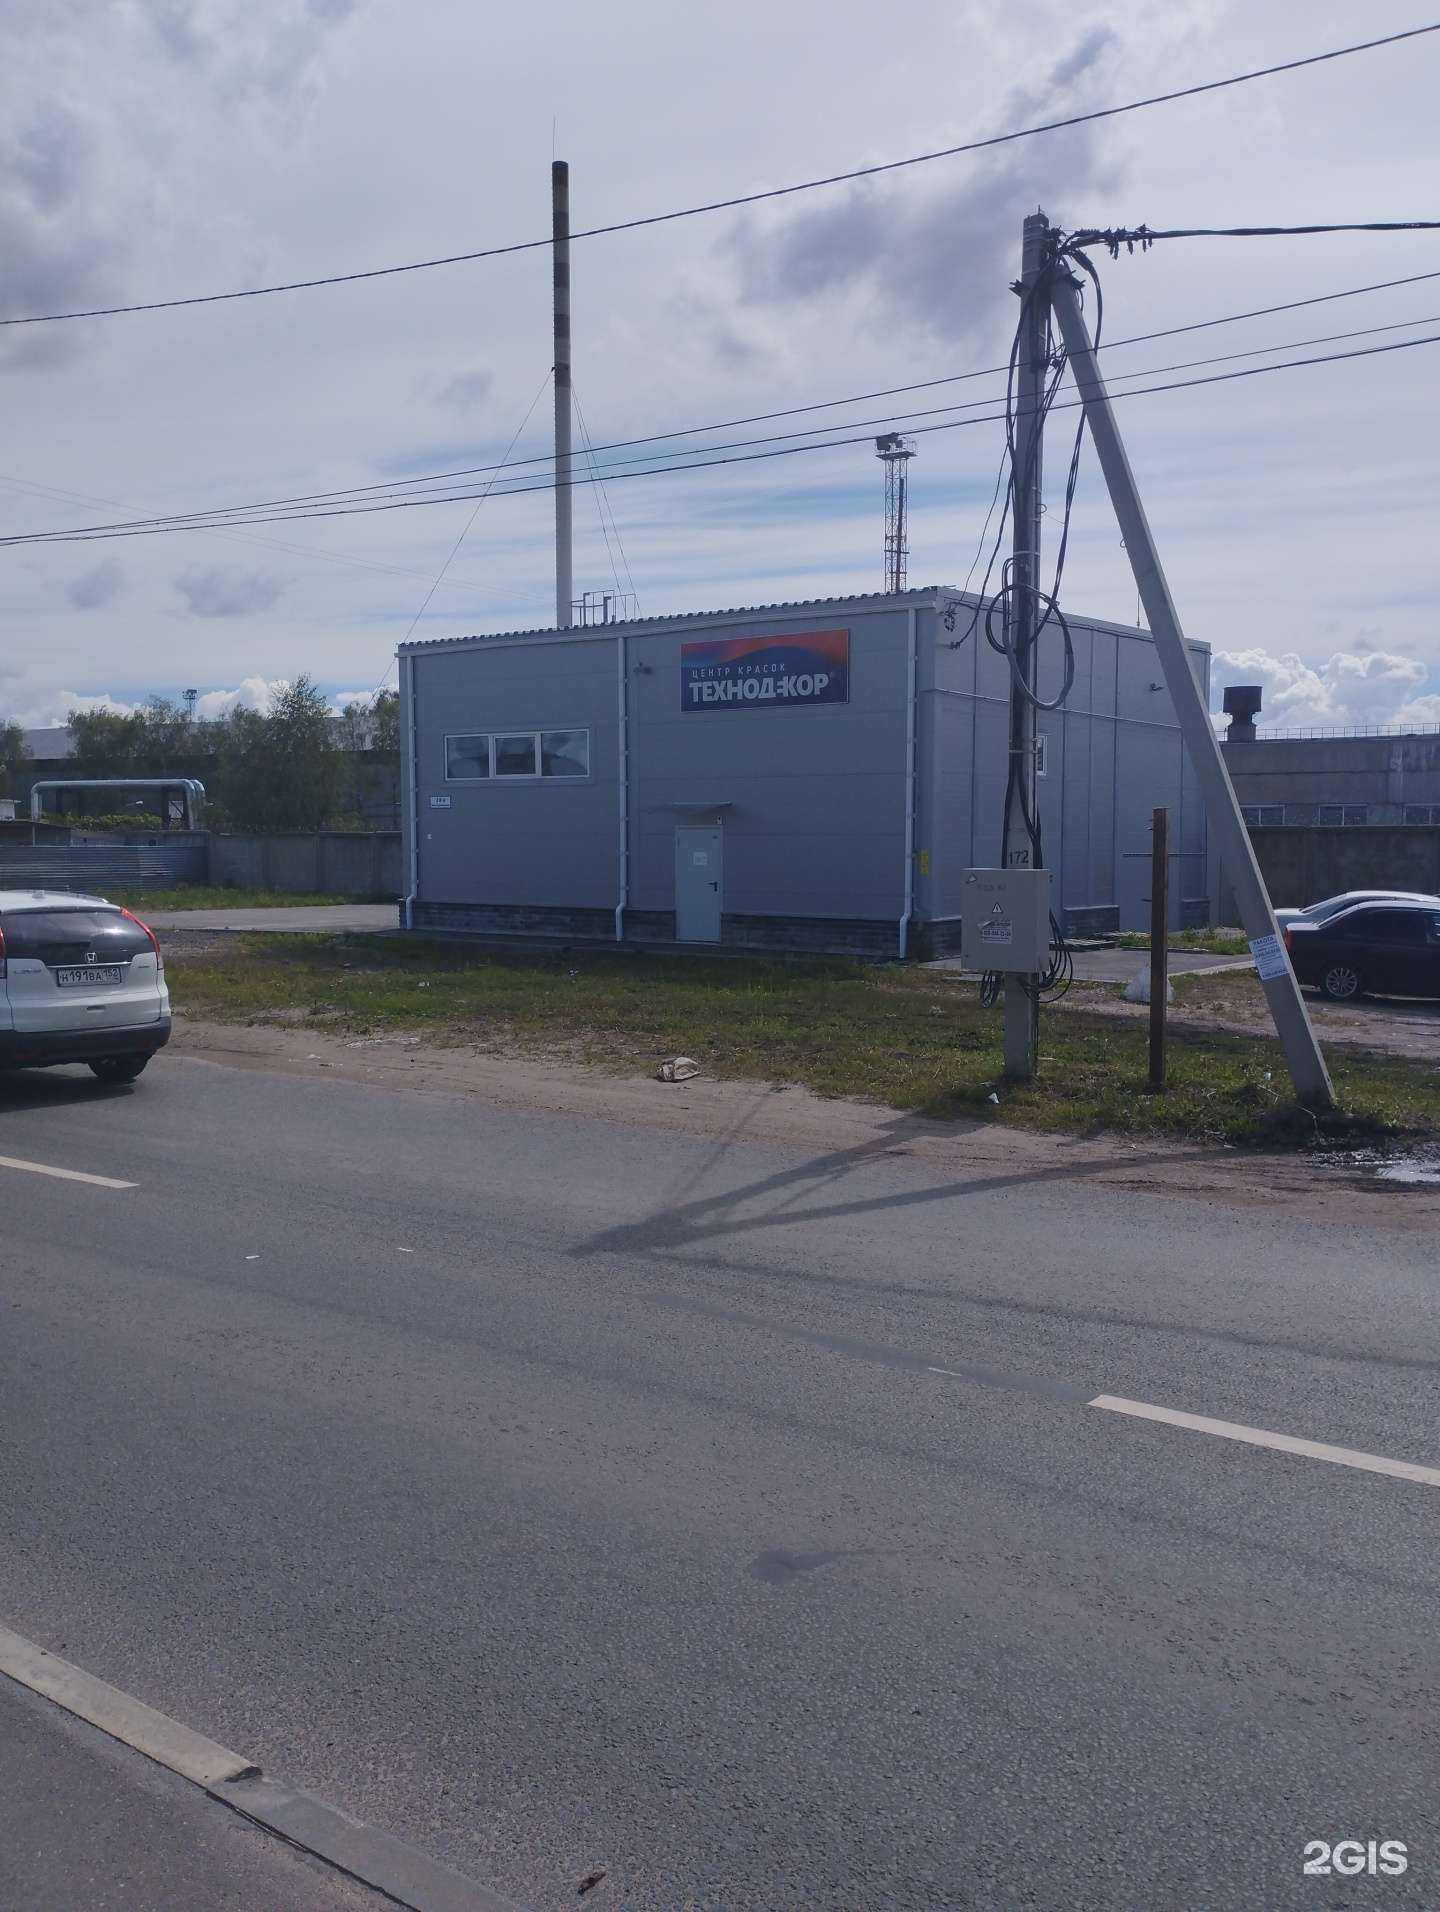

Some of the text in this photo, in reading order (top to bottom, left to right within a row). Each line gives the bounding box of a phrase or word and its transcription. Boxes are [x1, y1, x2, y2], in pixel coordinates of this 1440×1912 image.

[692, 663, 785, 679] ЦЕНТР КРАСОК
[1009, 850, 1029, 864] 172
